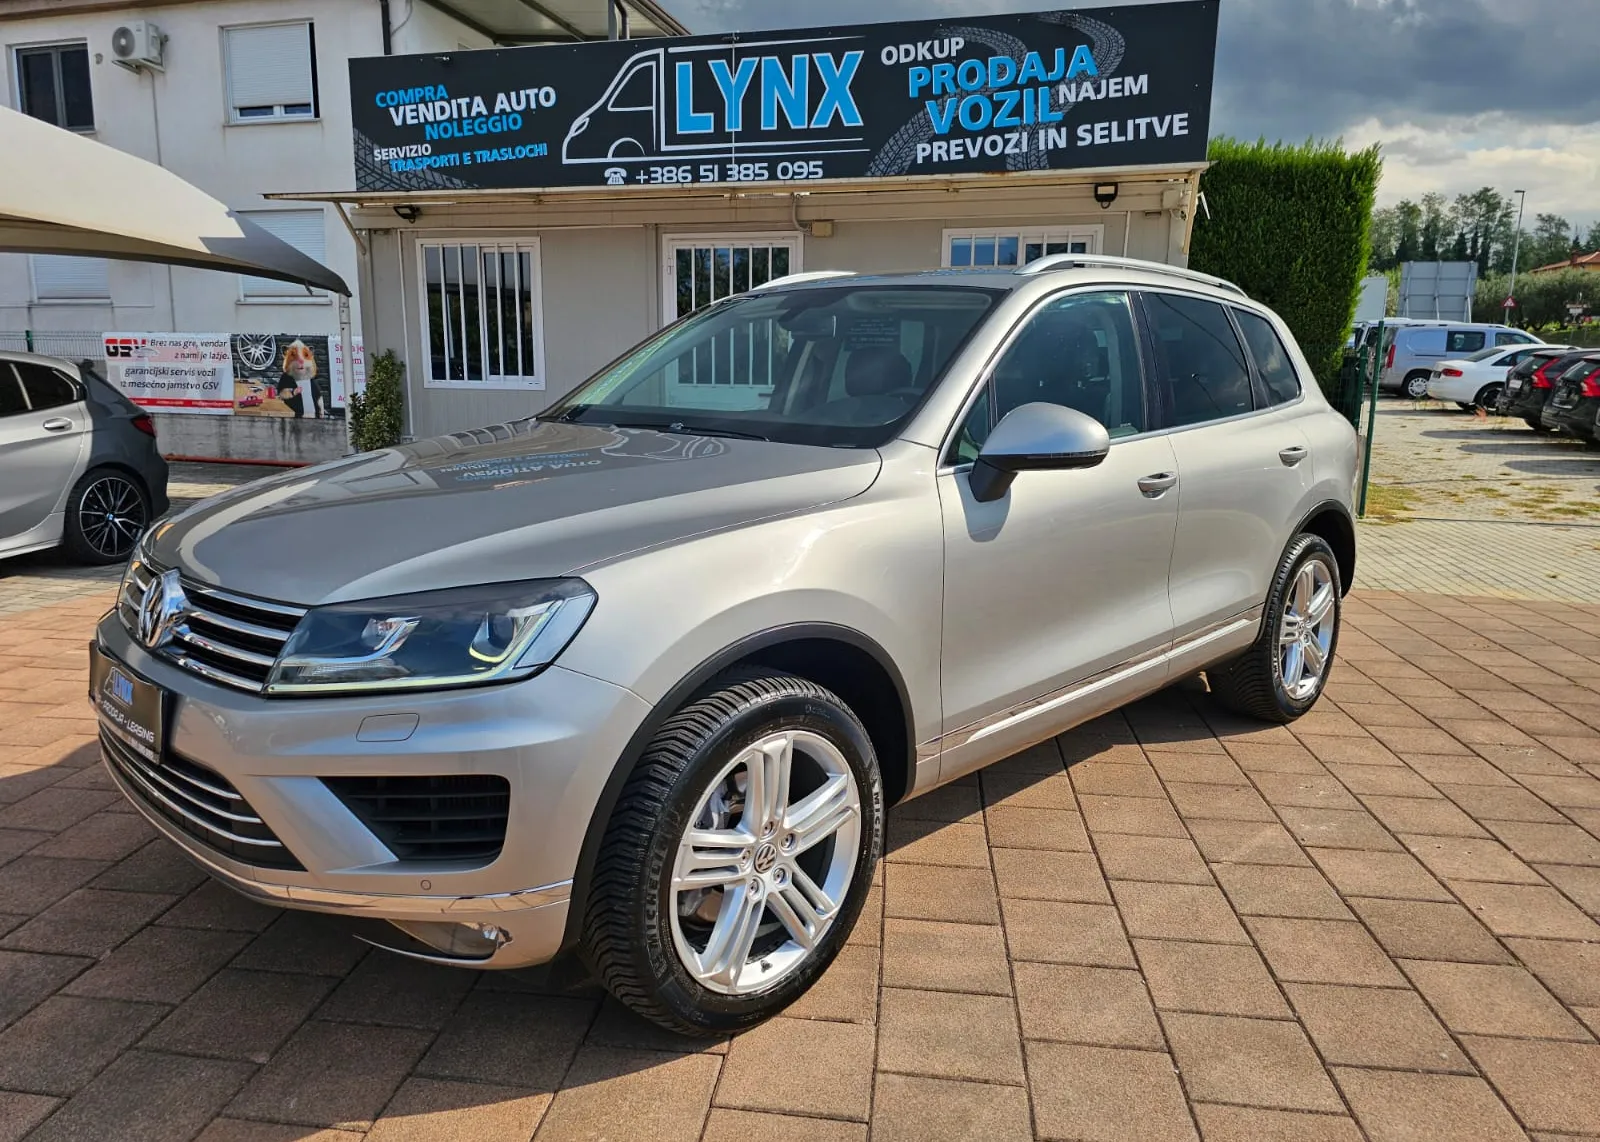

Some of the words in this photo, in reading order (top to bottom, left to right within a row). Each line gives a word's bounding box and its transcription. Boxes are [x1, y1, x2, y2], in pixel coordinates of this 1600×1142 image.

[881, 37, 965, 66] ODKUP
[908, 44, 1099, 98] PRODAJA
[375, 84, 449, 108] COMPRA
[675, 50, 865, 134] LYNX
[1059, 74, 1149, 105] NAJEM
[389, 96, 489, 127] VENDITA
[494, 86, 557, 114] AUTO
[925, 86, 1065, 135] VOZIL
[424, 113, 523, 141] NOLEGGIO
[916, 131, 1028, 164] PREVOZI
[1038, 127, 1067, 150] IN
[1077, 113, 1189, 147] SELITVE
[373, 143, 432, 162] SERVIZIO
[389, 153, 460, 173] TRASPORTI
[463, 151, 472, 165] E
[474, 142, 548, 164] TRASLOCHI
[635, 165, 694, 185] +386
[700, 164, 719, 182] 51
[726, 162, 769, 181] 385
[777, 160, 824, 180] 095
[150, 339, 167, 347] Brez
[200, 339, 227, 348] vendar
[180, 351, 198, 360] nami
[200, 351, 208, 361] je
[125, 367, 169, 378] garancijski
[170, 368, 196, 377] servis
[197, 368, 216, 377] vozil
[167, 380, 200, 391] jamstvo
[202, 381, 219, 390] GSV
